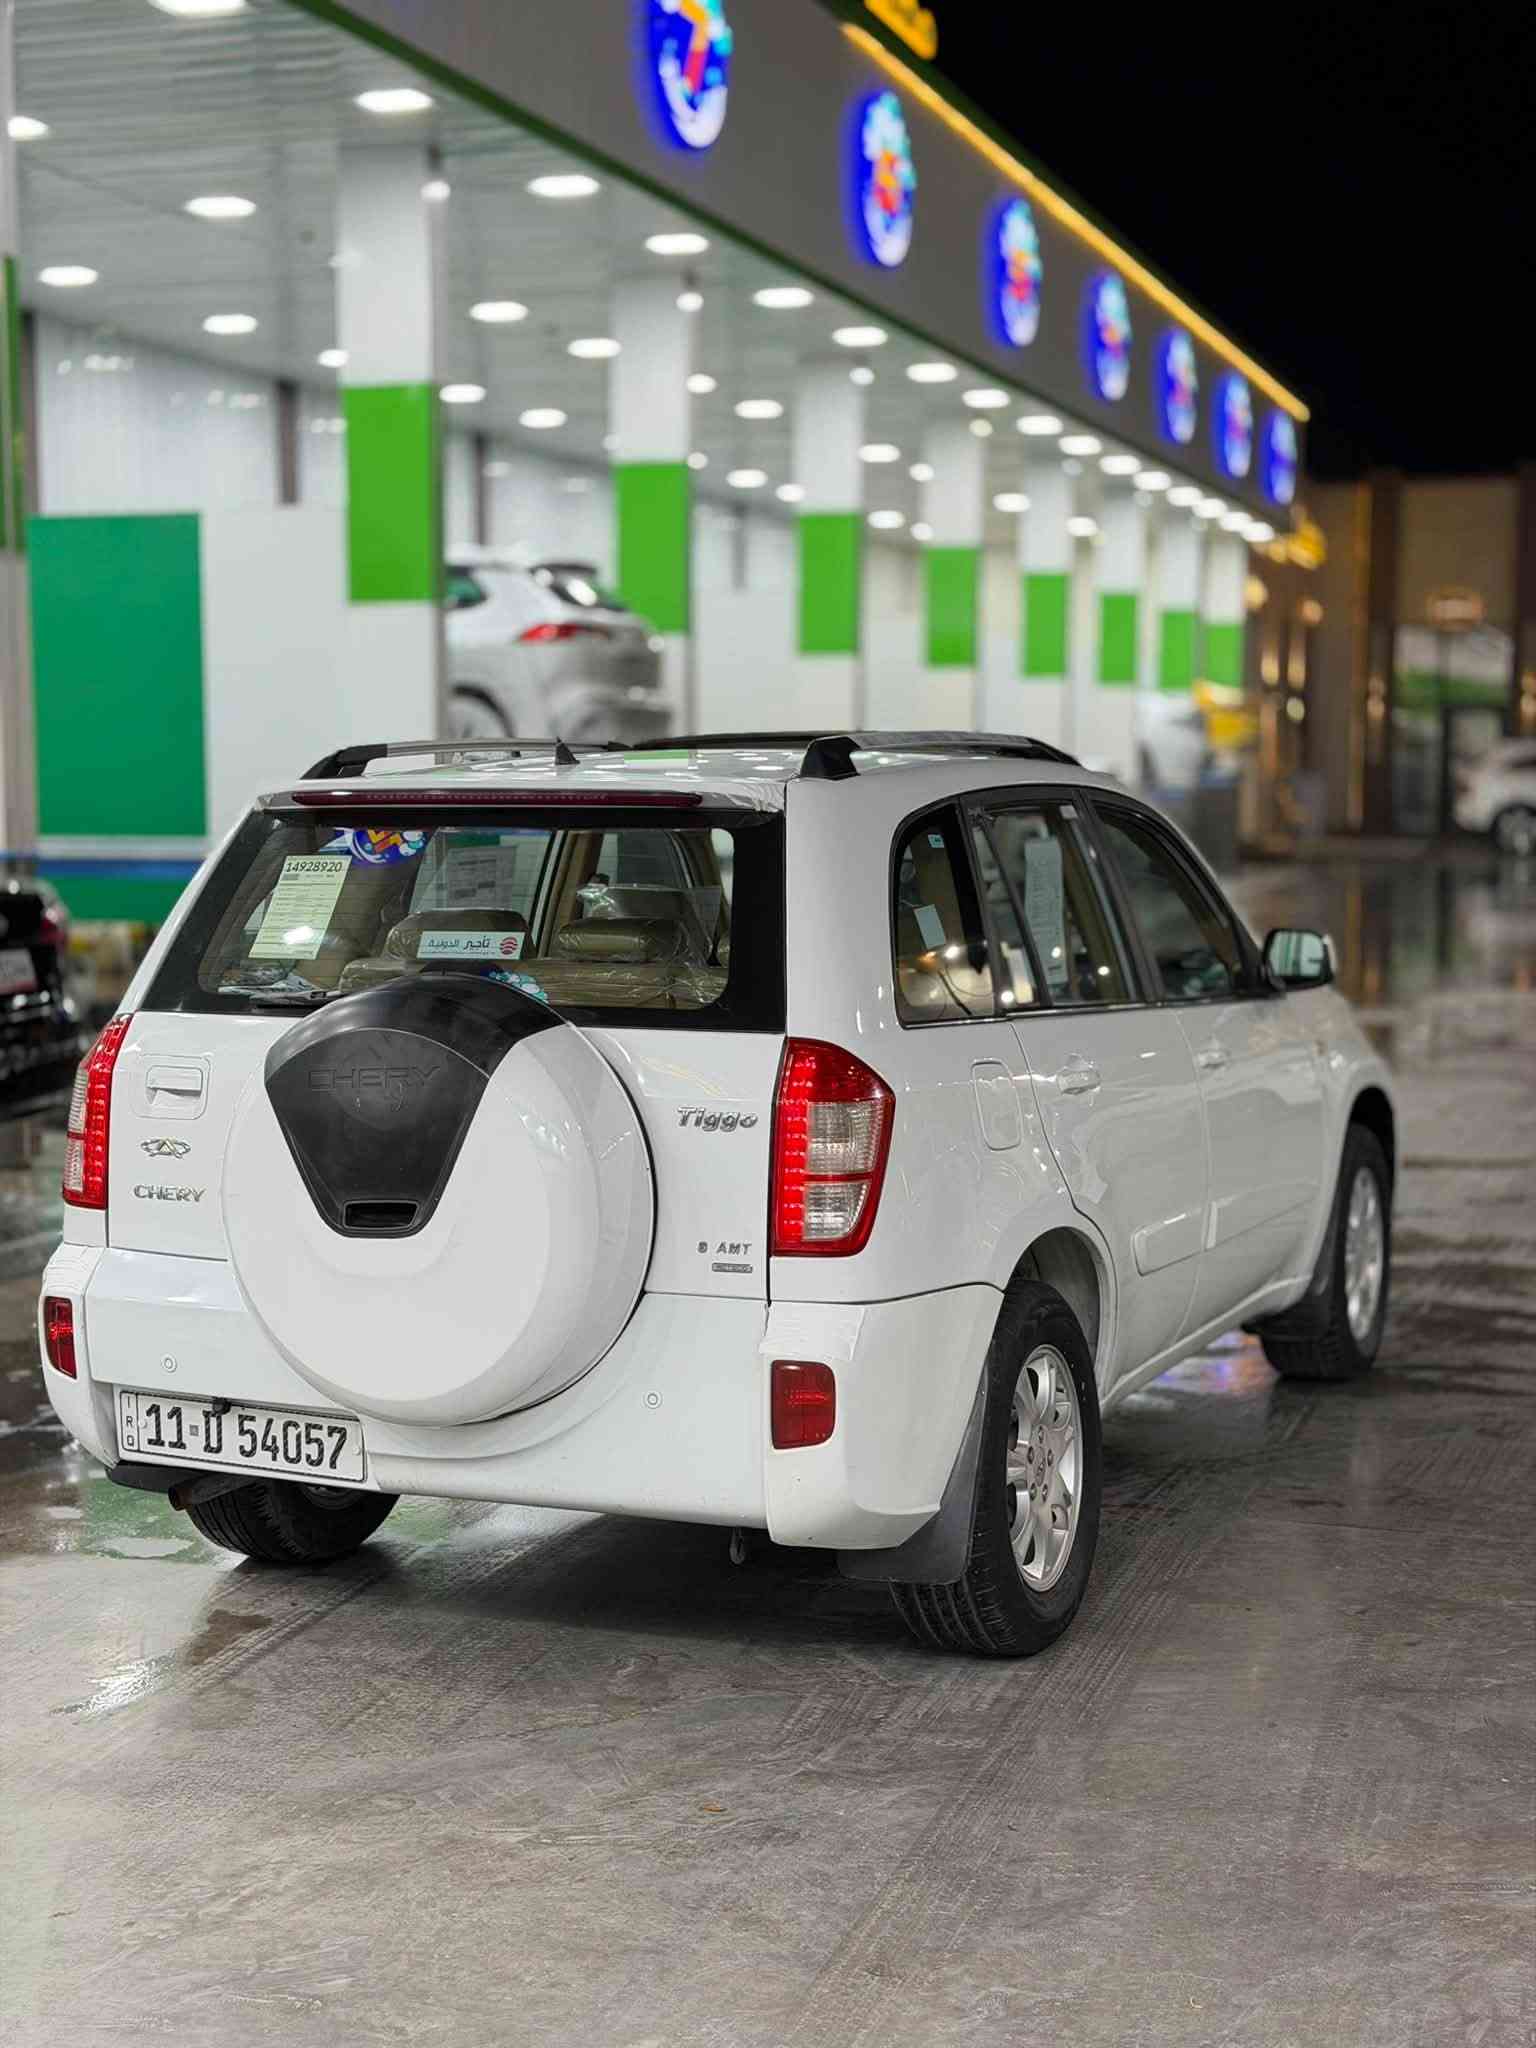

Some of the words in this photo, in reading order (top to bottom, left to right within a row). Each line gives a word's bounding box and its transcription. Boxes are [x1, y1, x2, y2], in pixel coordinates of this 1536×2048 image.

[286, 861, 343, 873] 14928920
[677, 1105, 759, 1133] Tiggo
[133, 1184, 207, 1202] CHERY
[146, 1403, 187, 1450] 11
[237, 1413, 348, 1470] 54057
